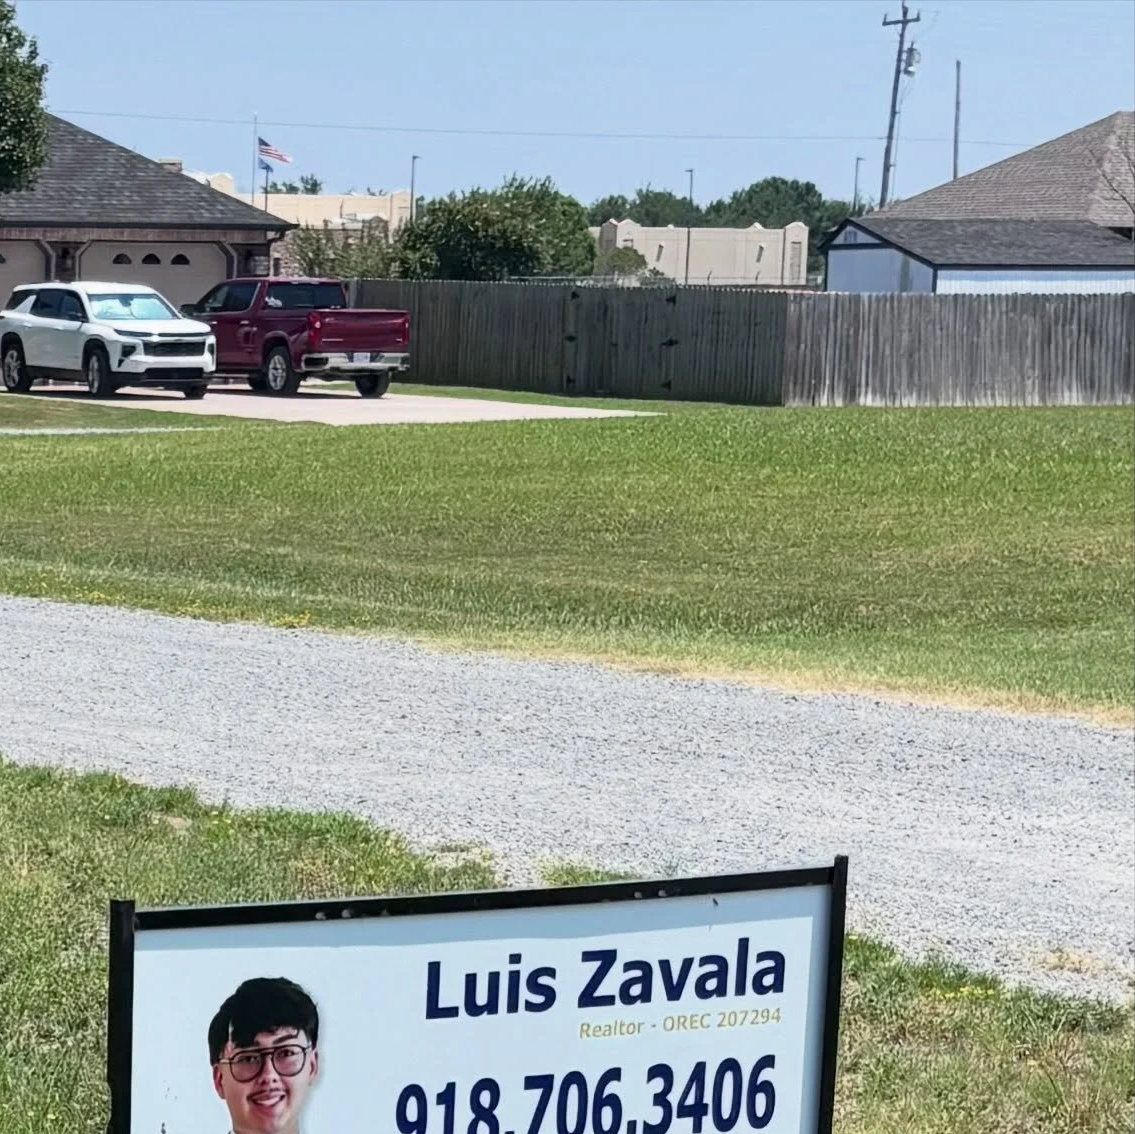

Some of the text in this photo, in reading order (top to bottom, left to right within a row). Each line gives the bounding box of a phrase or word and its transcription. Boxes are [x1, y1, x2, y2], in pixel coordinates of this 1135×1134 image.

[425, 936, 786, 1020] Luis Zavala
[579, 1019, 645, 1039] Realtor
[662, 1012, 712, 1033] OREC
[716, 1007, 782, 1028] 207294
